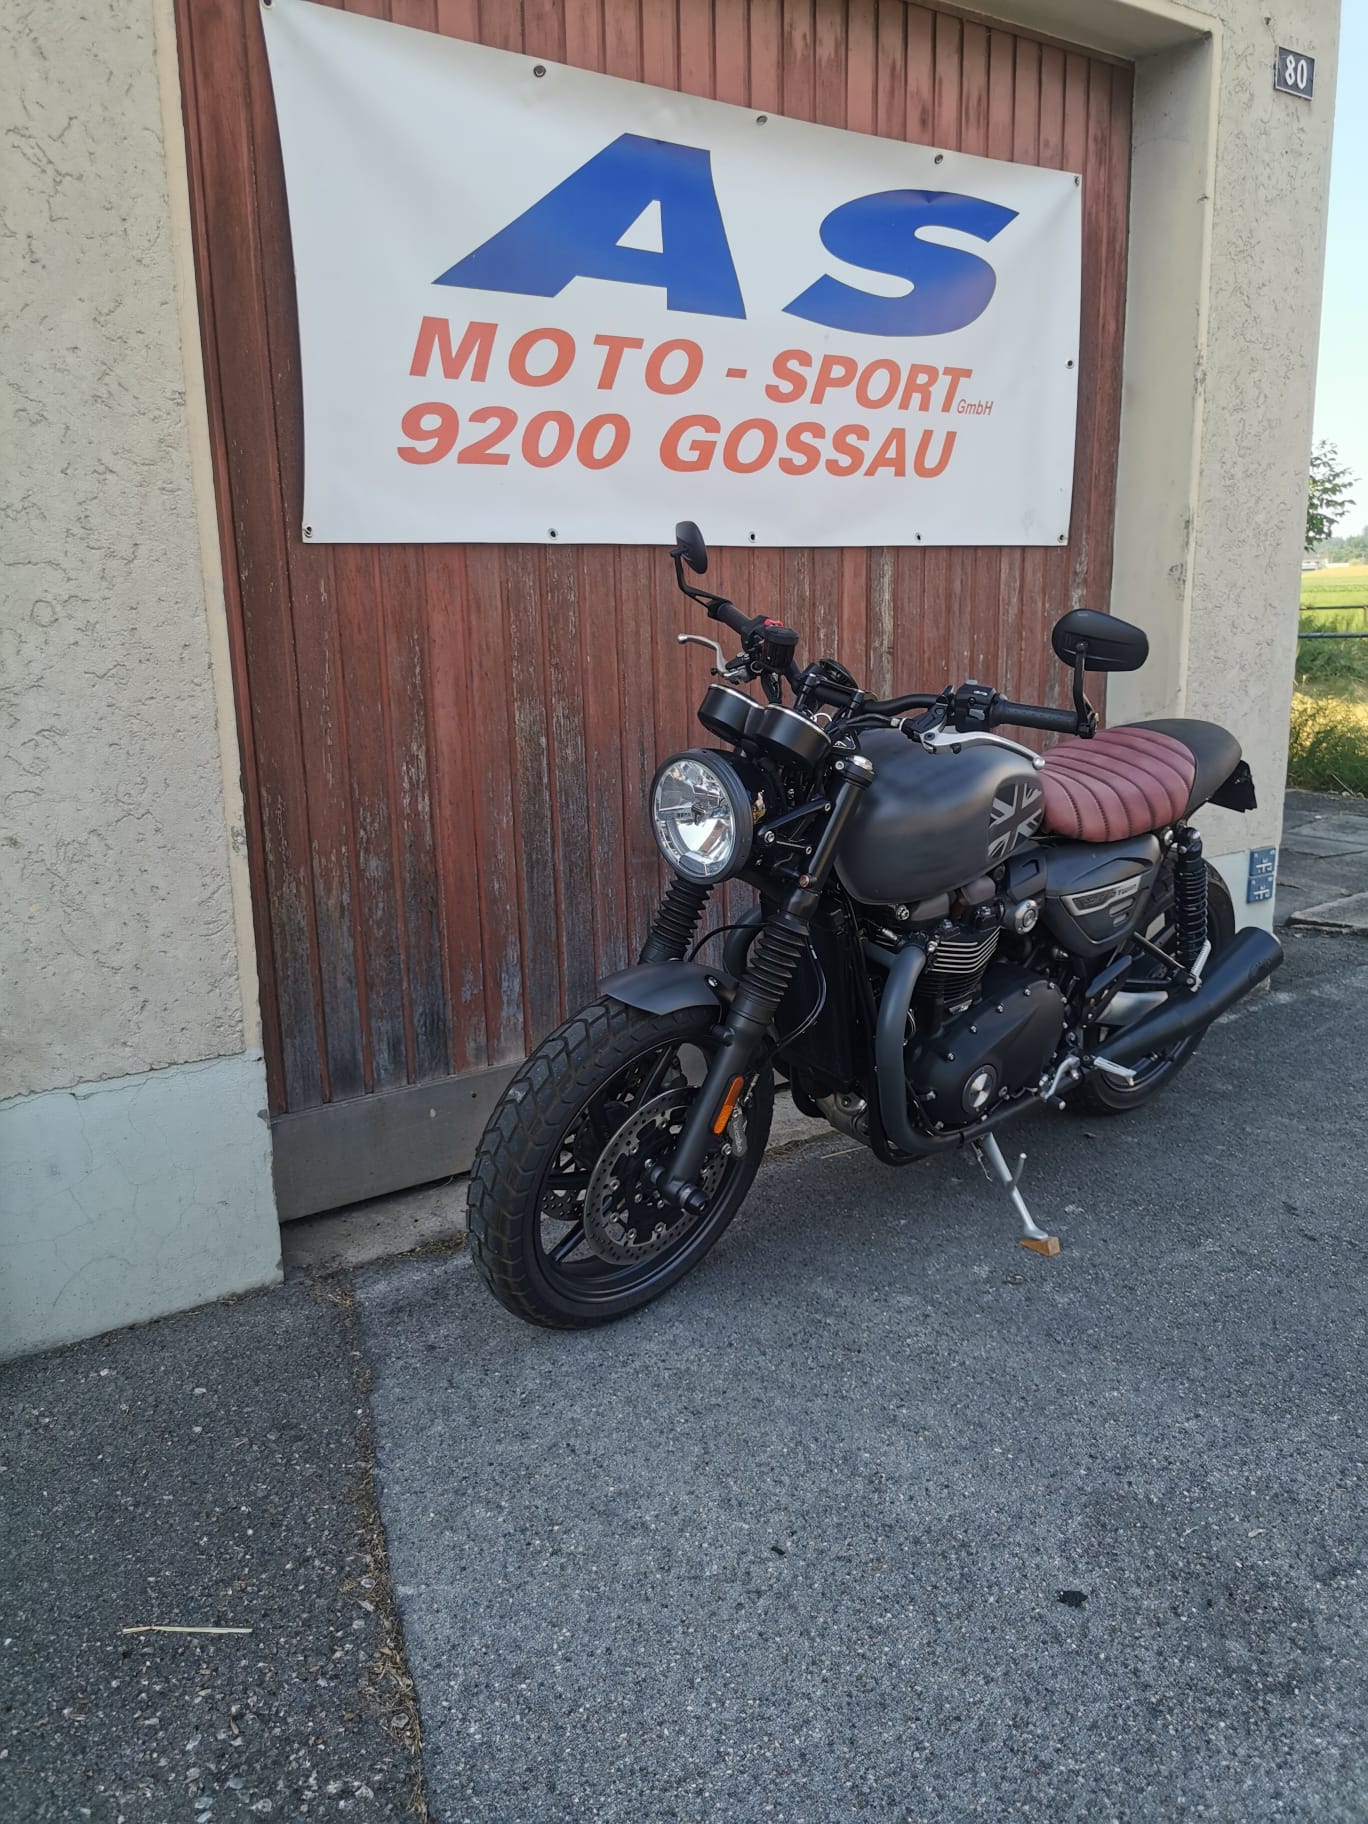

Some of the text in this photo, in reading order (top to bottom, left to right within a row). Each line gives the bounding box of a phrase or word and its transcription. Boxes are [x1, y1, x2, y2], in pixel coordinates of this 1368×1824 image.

[1286, 55, 1307, 89] 80
[409, 315, 704, 396] MOTO
[766, 350, 973, 413] SPORT
[957, 399, 993, 416] GmbH
[397, 401, 957, 478] 9200 GOSSAU
